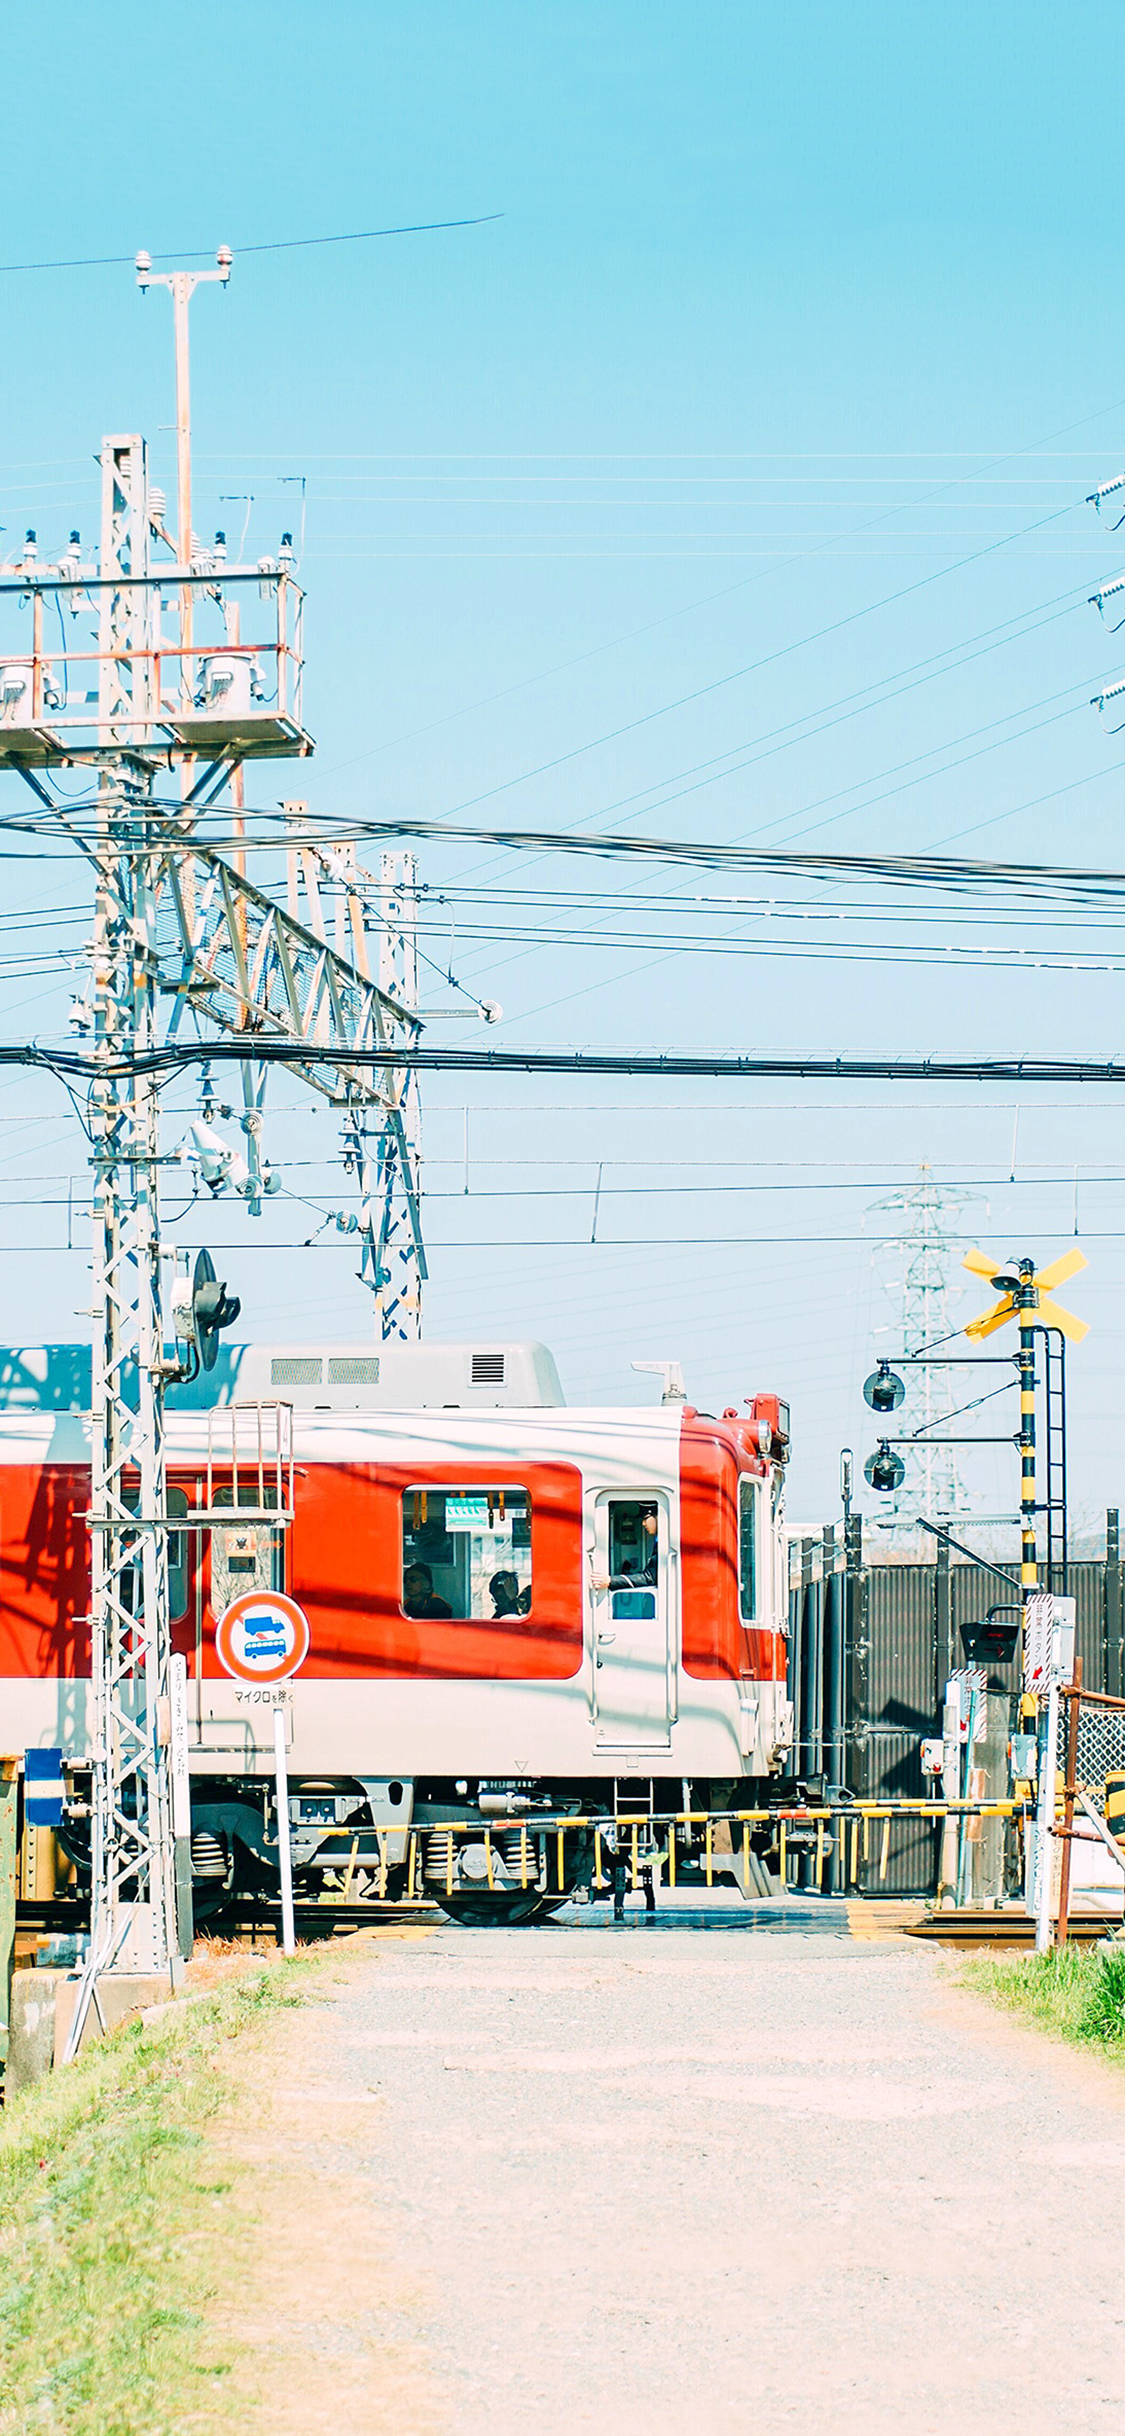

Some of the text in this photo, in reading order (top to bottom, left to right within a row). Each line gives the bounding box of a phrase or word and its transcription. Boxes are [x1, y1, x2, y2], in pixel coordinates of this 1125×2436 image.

[235, 1690, 294, 1703] マイクロを除く
